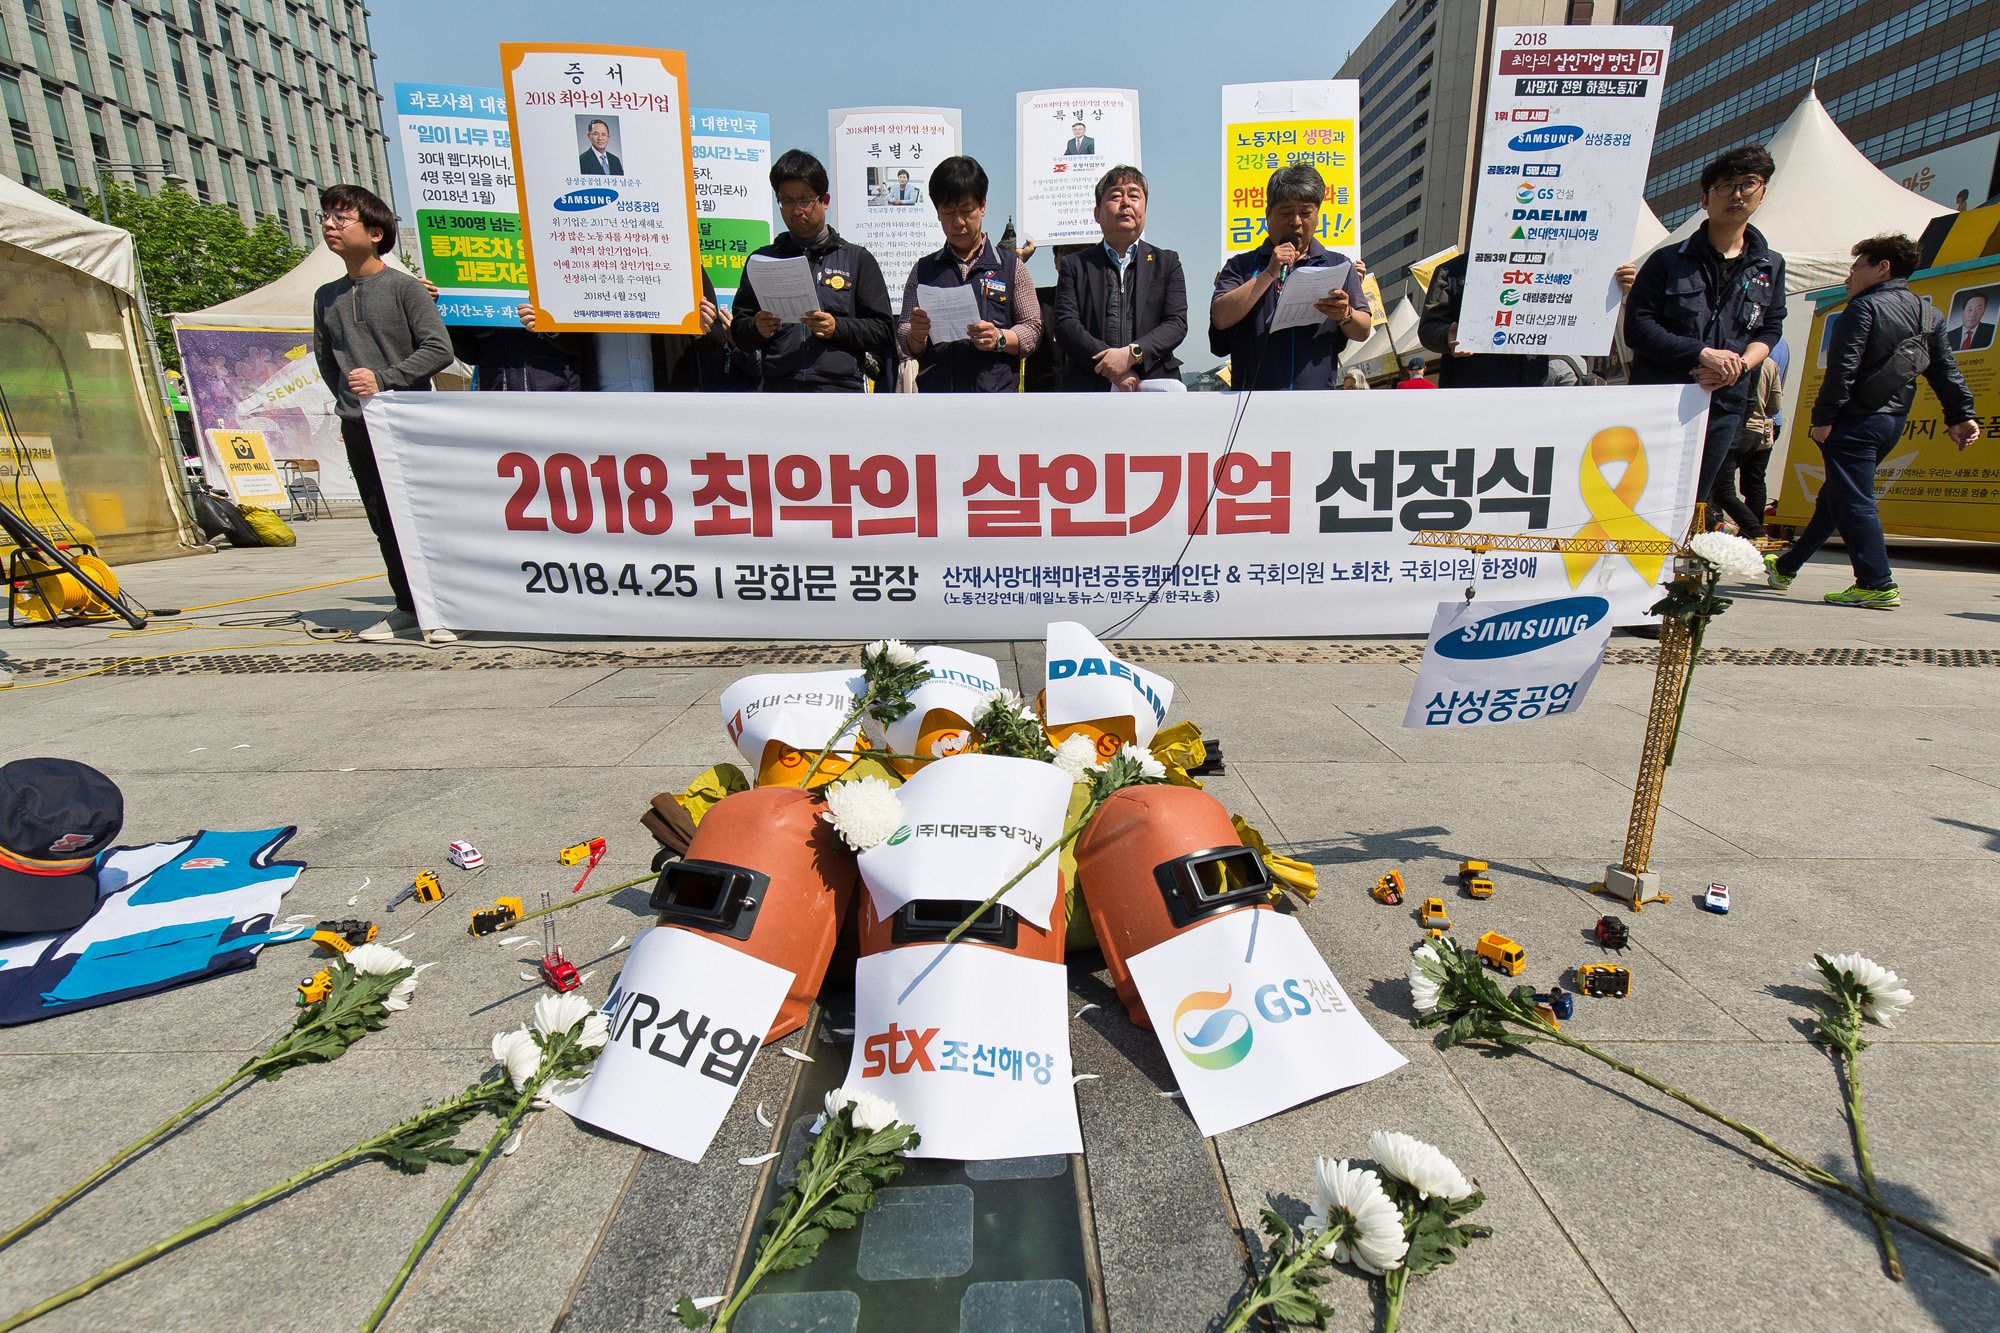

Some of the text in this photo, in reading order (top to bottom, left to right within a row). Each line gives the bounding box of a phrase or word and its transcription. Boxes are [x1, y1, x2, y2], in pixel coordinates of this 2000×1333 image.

[1514, 33, 1547, 45] 2018
[1511, 53, 1635, 72] 최악의 살인기업 명단
[1561, 80, 1582, 94] 전원
[409, 91, 473, 112] 과로사회
[525, 89, 669, 113] 2018 최악의 살인기업
[1494, 111, 1508, 121] 1위
[702, 115, 758, 135] 대한민국
[887, 125, 919, 135] 살인기업
[921, 125, 945, 136] 선정식
[455, 127, 488, 146] 너무
[1237, 128, 1346, 148] 노동자의 생명과
[1518, 133, 1632, 147] SAMSUNG 삼성중공업
[418, 152, 511, 170] 30대 웹디자이너,
[1236, 150, 1347, 170] 건강을 위협하는
[1486, 165, 1520, 176] 공동2위
[420, 170, 439, 185] 4명
[442, 170, 466, 186] 몫의
[469, 172, 493, 187] 일을
[565, 176, 602, 187] 삼성중공업
[603, 178, 618, 187] 사장
[422, 189, 496, 205] (2018년 1월)
[1232, 187, 1268, 208] 위험
[1537, 188, 1574, 200] GS 건설
[561, 195, 660, 213] SAMSUNG 삼성중공업
[1512, 209, 1587, 222] DAELIM
[426, 215, 516, 233] 1년 300명 넘는
[552, 217, 665, 229] 위 기업은 2017년 산업재해로
[549, 231, 670, 244] 가장 많은 노동자를 사망하게 한
[1527, 227, 1599, 242] 현대엔지니어링
[430, 235, 513, 259] 통계조차
[570, 246, 652, 257] 최악의 살인기업이다.
[729, 240, 748, 252] 2달
[716, 254, 727, 268] 더
[1475, 253, 1507, 263] 공동3위
[553, 260, 672, 271] 이에 2018 최악의 살인기업으로
[563, 273, 662, 286] 선정하여 증서를 수여한다
[1535, 273, 1573, 286] 조선해양
[584, 291, 647, 303] 2018년 4월 25일
[1522, 292, 1574, 305] 대림종합건설
[573, 310, 661, 320] 산재사망대책마련 공동캠페인단
[1515, 313, 1578, 327] 현대산업개발
[1507, 333, 1548, 346] KR산업
[266, 375, 313, 402] SEWOL
[230, 462, 271, 472] PHOTO WALL
[1928, 468, 1952, 478] 우리는
[497, 446, 1555, 538] 2018 최악의 살인기업 선정식
[520, 560, 698, 598] 2018.4.25
[734, 564, 837, 602] 광화문
[850, 565, 919, 602] 광장
[942, 564, 1221, 589] 산재사망대책마련공동캠페인단
[1226, 565, 1241, 584] &
[1247, 562, 1324, 585] 국회의원
[1331, 560, 1393, 583] 노회찬,
[1400, 558, 1476, 582] 국회의원
[1481, 556, 1538, 579] 한정애
[1461, 614, 1589, 643] SAMSUNG
[1048, 657, 1166, 728] DAELIM
[1425, 681, 1578, 727] 삼성중공업
[1255, 978, 1348, 1023] GS 건설
[940, 1040, 1054, 1086] 조선해양
